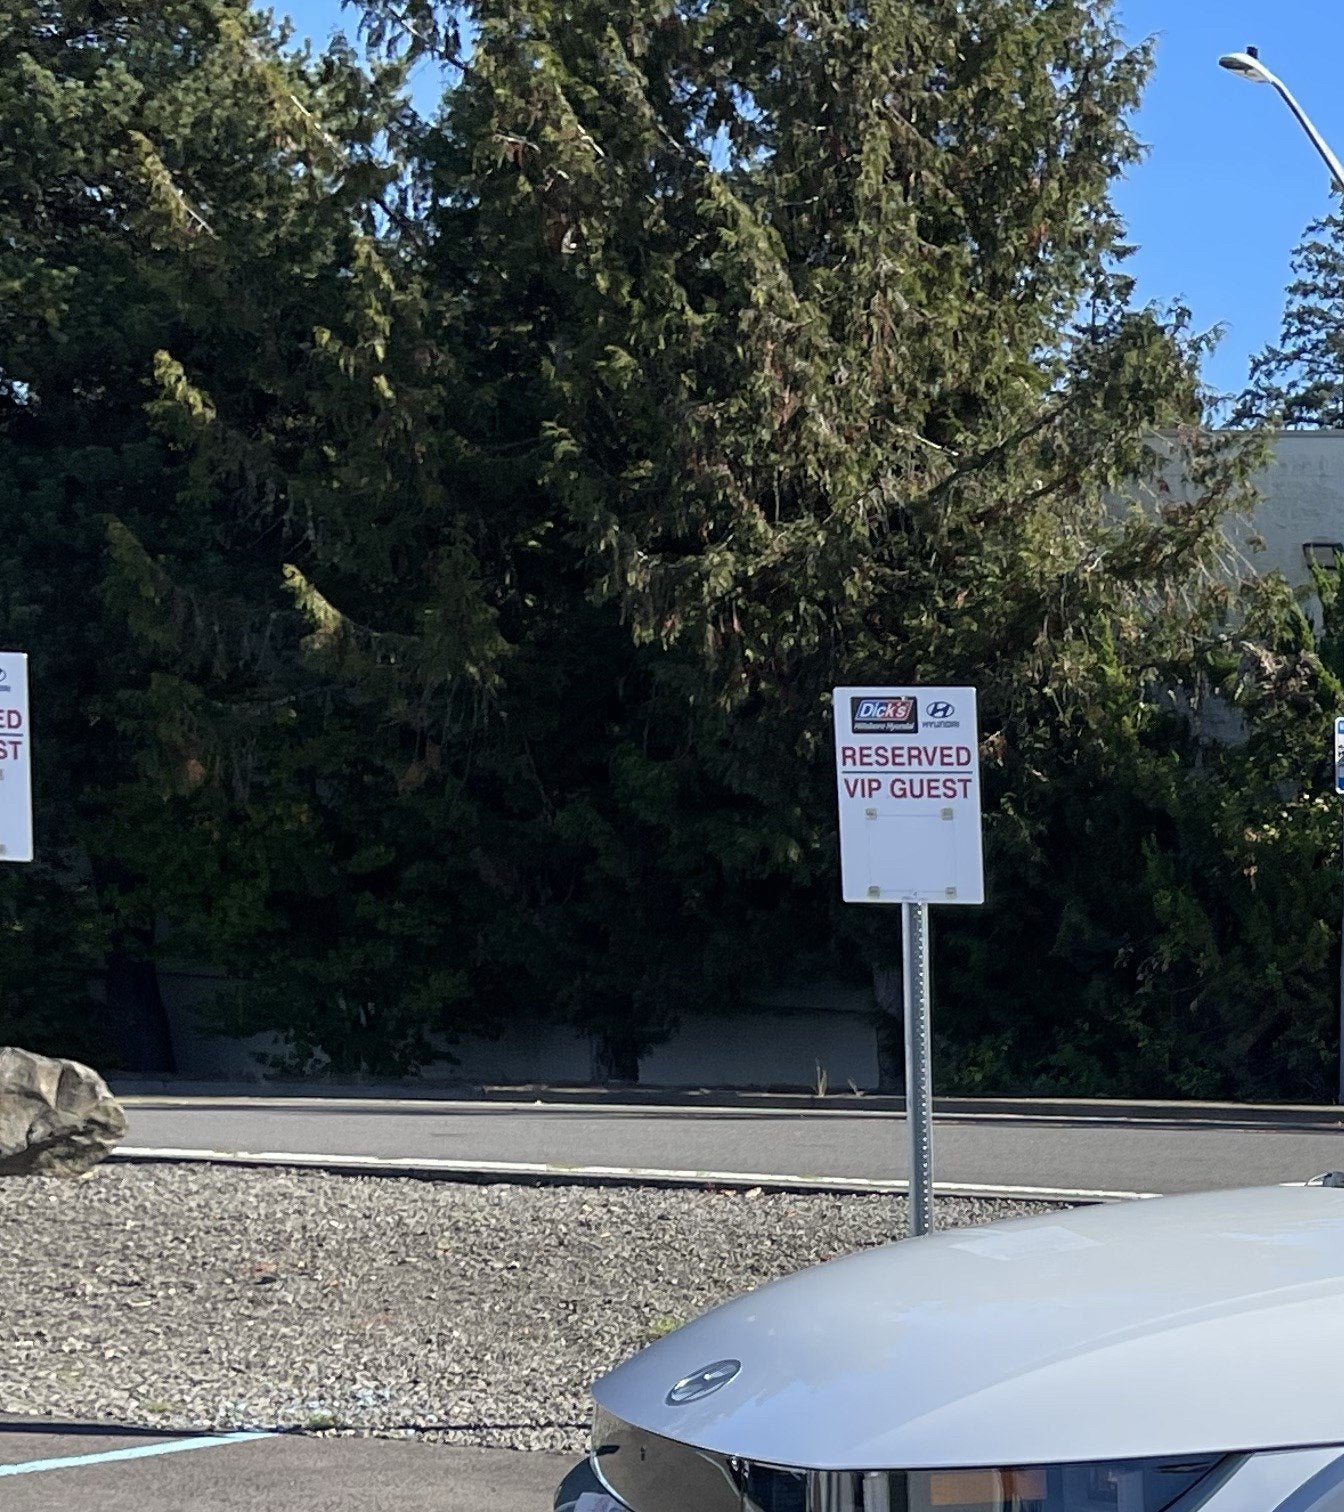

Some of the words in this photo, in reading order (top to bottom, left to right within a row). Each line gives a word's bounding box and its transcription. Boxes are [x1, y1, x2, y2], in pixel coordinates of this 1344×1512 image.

[841, 746, 972, 767] RESERVED
[843, 778, 882, 799] VIP
[889, 777, 972, 799] GUEST
